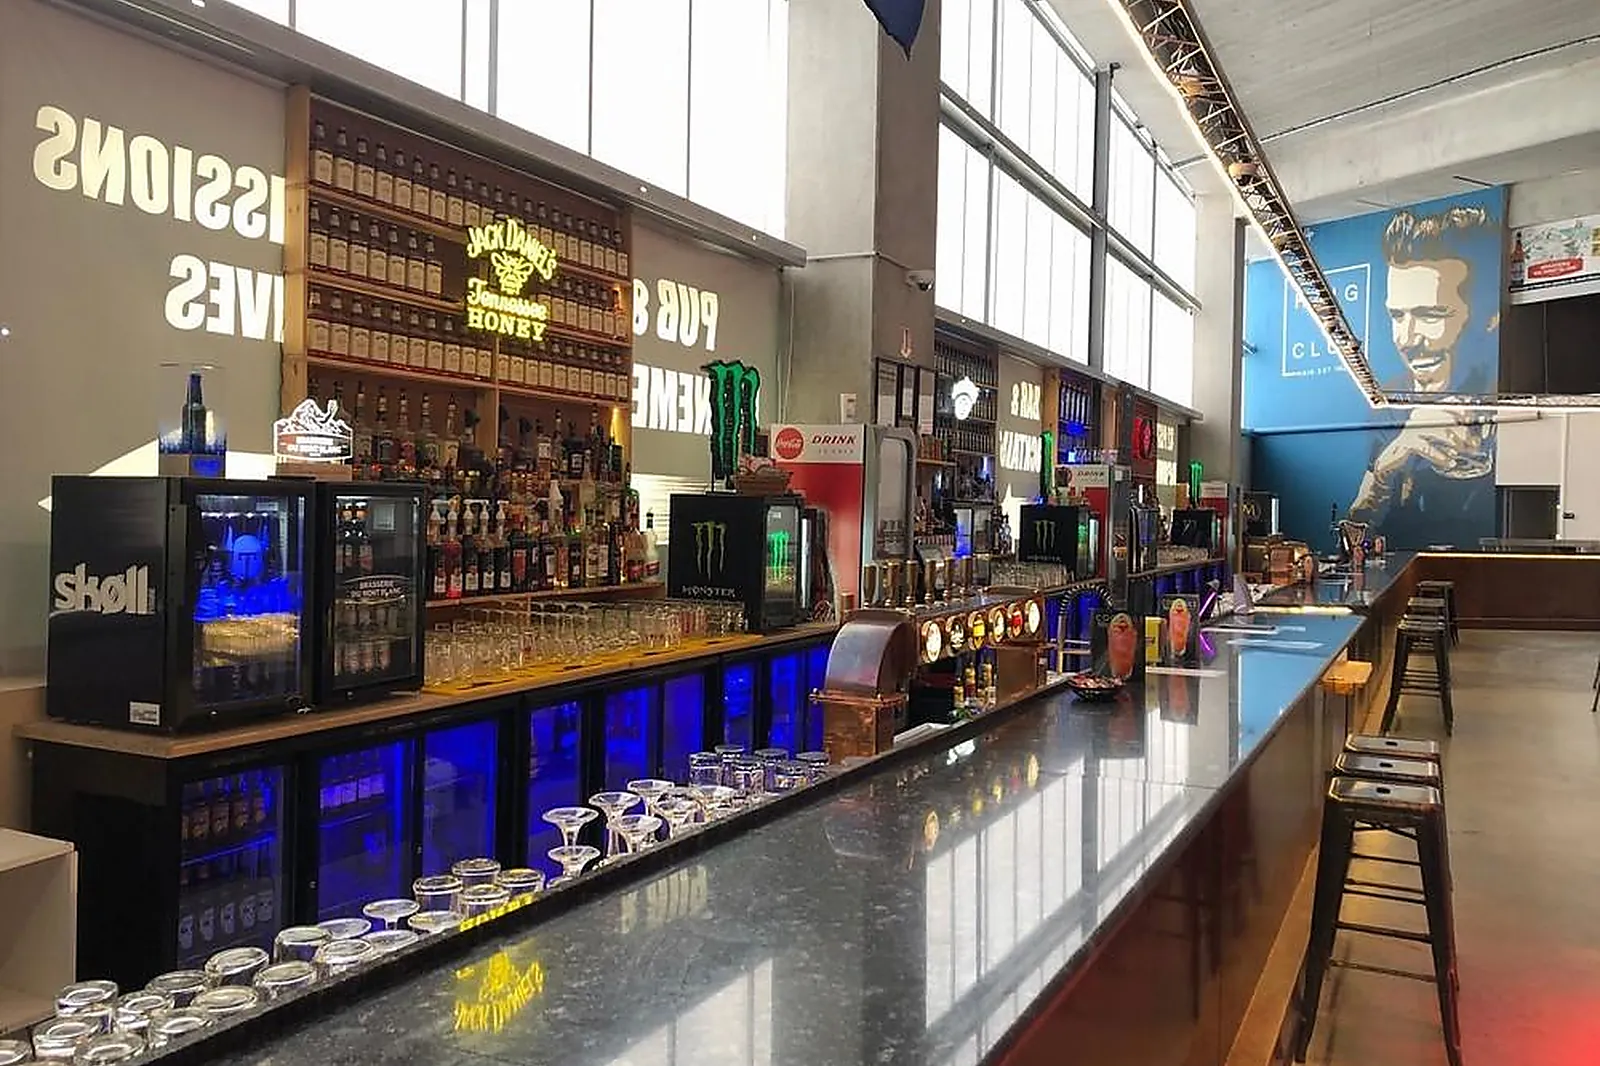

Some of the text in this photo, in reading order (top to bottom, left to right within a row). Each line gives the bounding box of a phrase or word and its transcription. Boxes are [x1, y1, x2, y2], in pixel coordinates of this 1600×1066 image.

[466, 223, 505, 259] JACK
[466, 306, 547, 340] HONEY
[811, 434, 857, 445] DRINK
